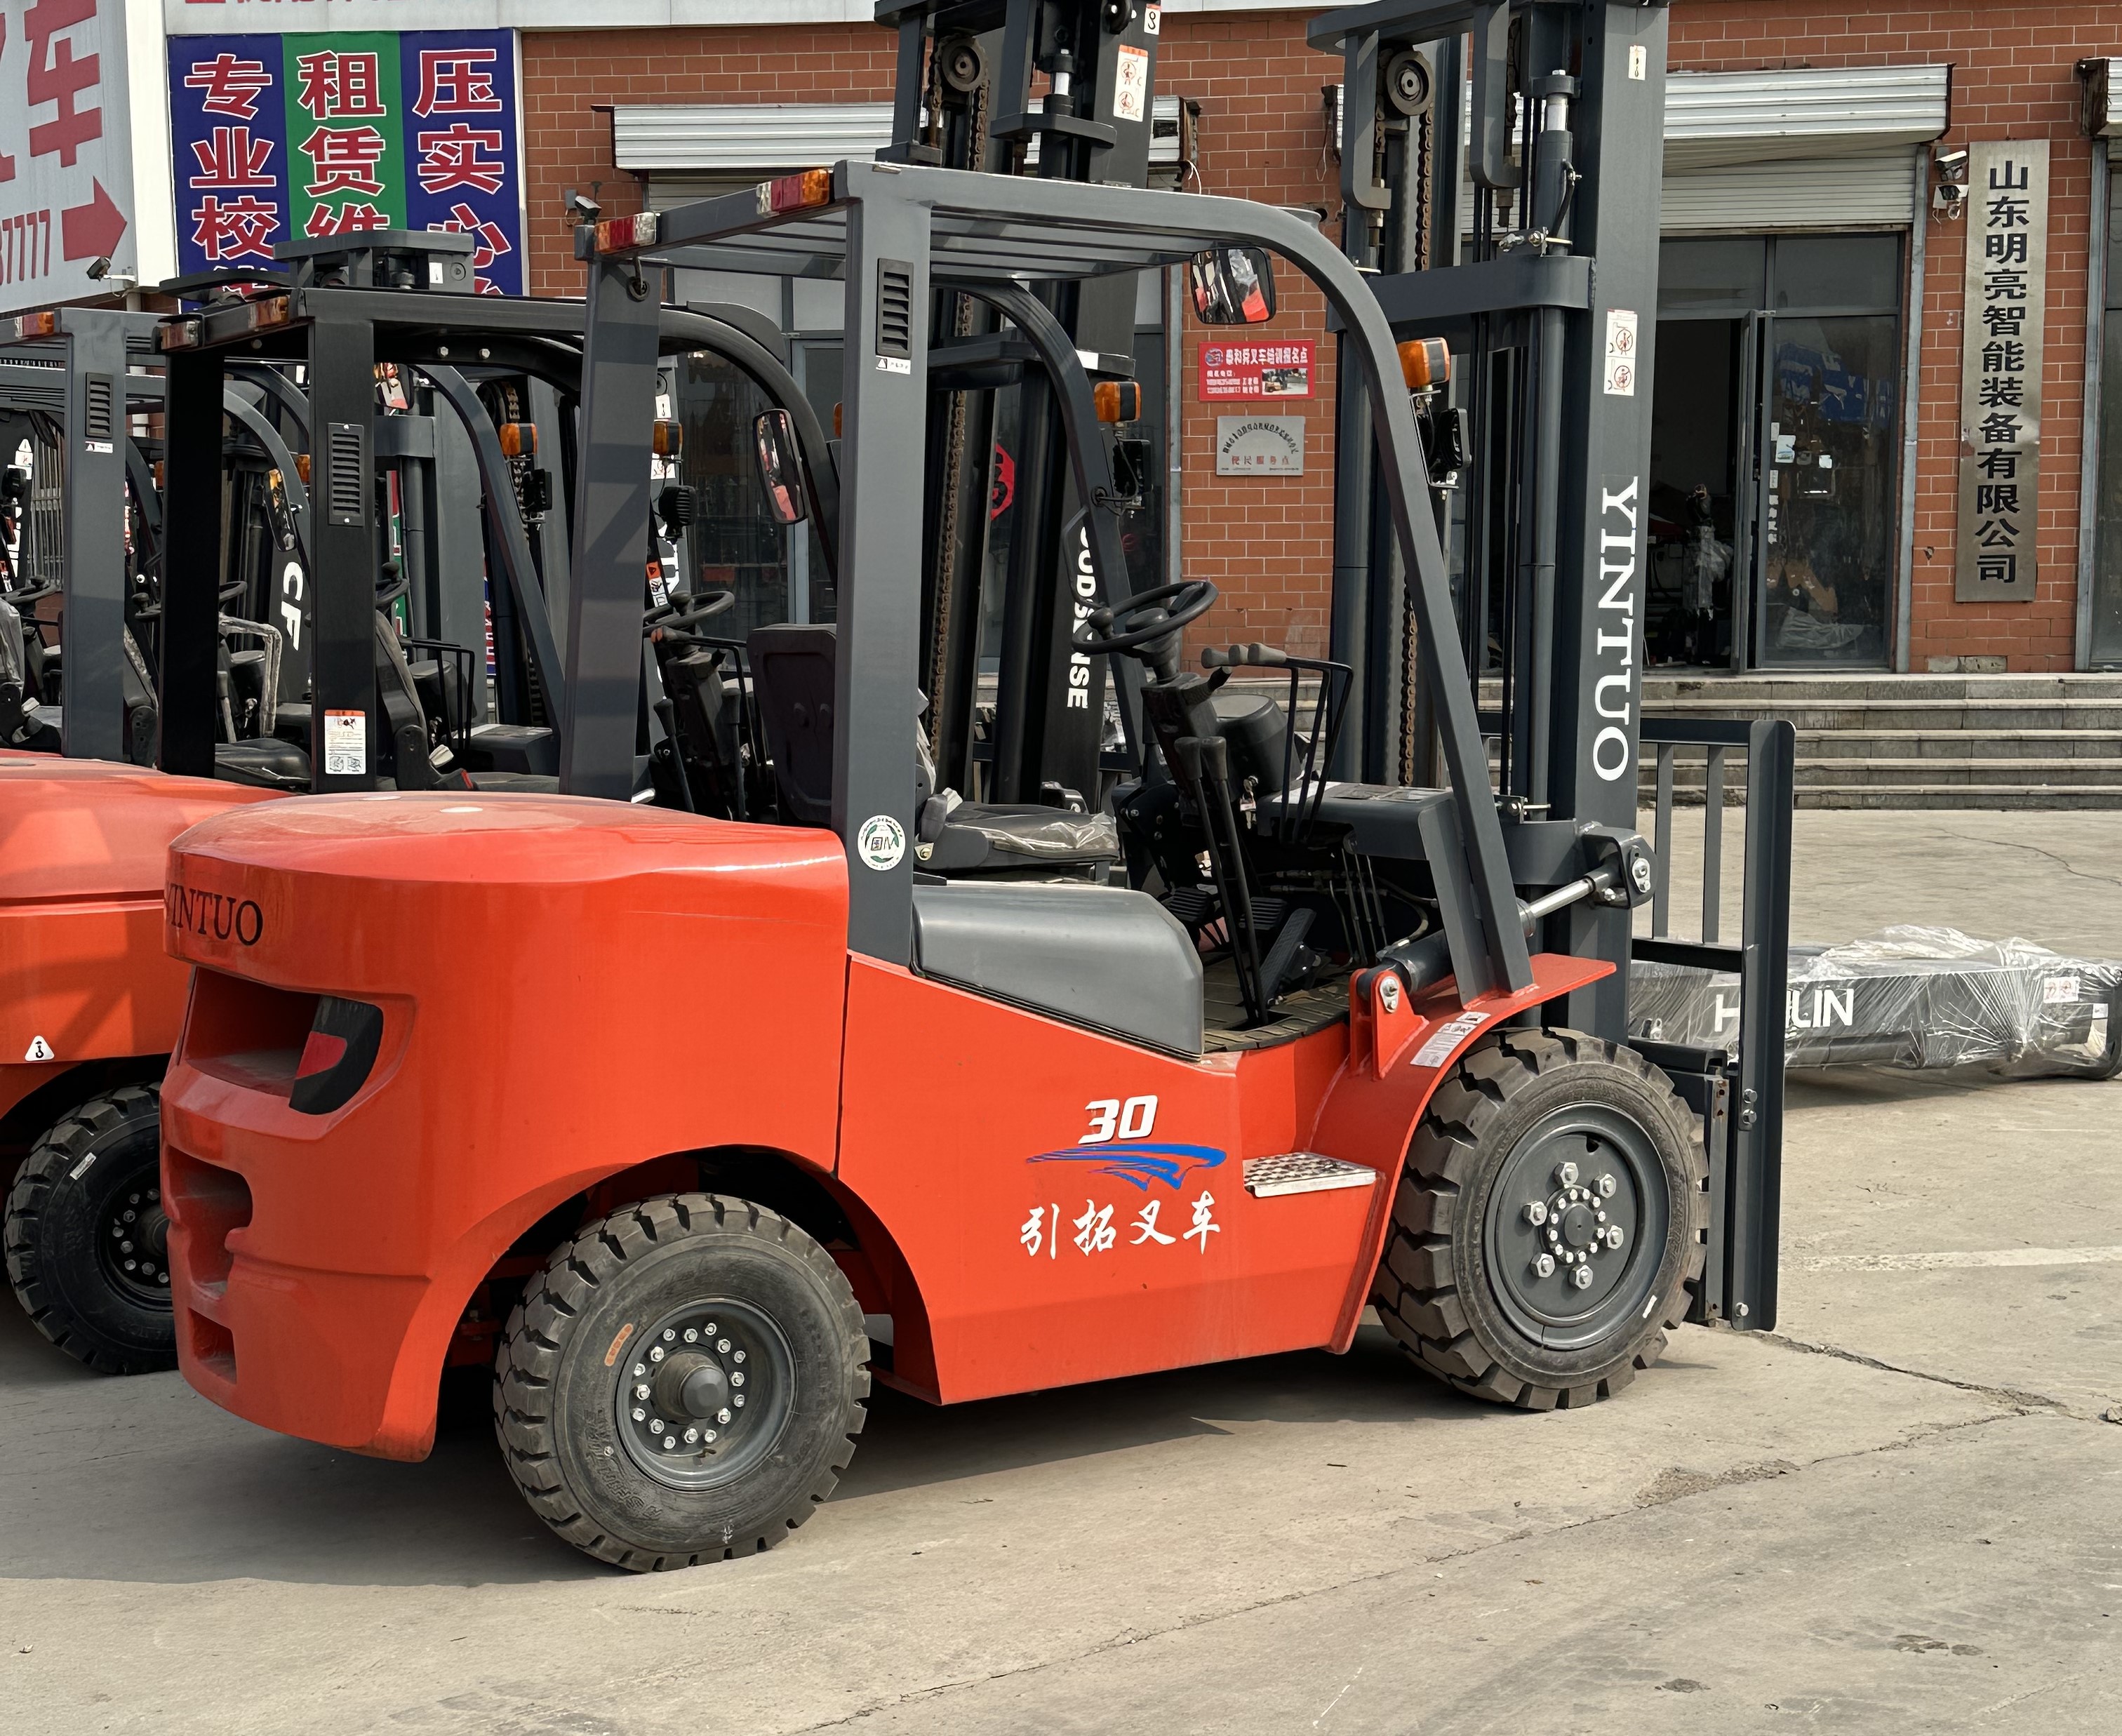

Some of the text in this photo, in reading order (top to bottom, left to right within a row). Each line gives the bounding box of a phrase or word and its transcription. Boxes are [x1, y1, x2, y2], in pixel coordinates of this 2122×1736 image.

[0, 0, 102, 182] 车
[0, 209, 51, 286] 7777
[1975, 160, 2030, 583] 山东明亮智能装备有限公司
[1592, 476, 1639, 781] YINTUO
[1078, 1095, 1158, 1144] 30
[1020, 1190, 1221, 1260] 引拓叉车
